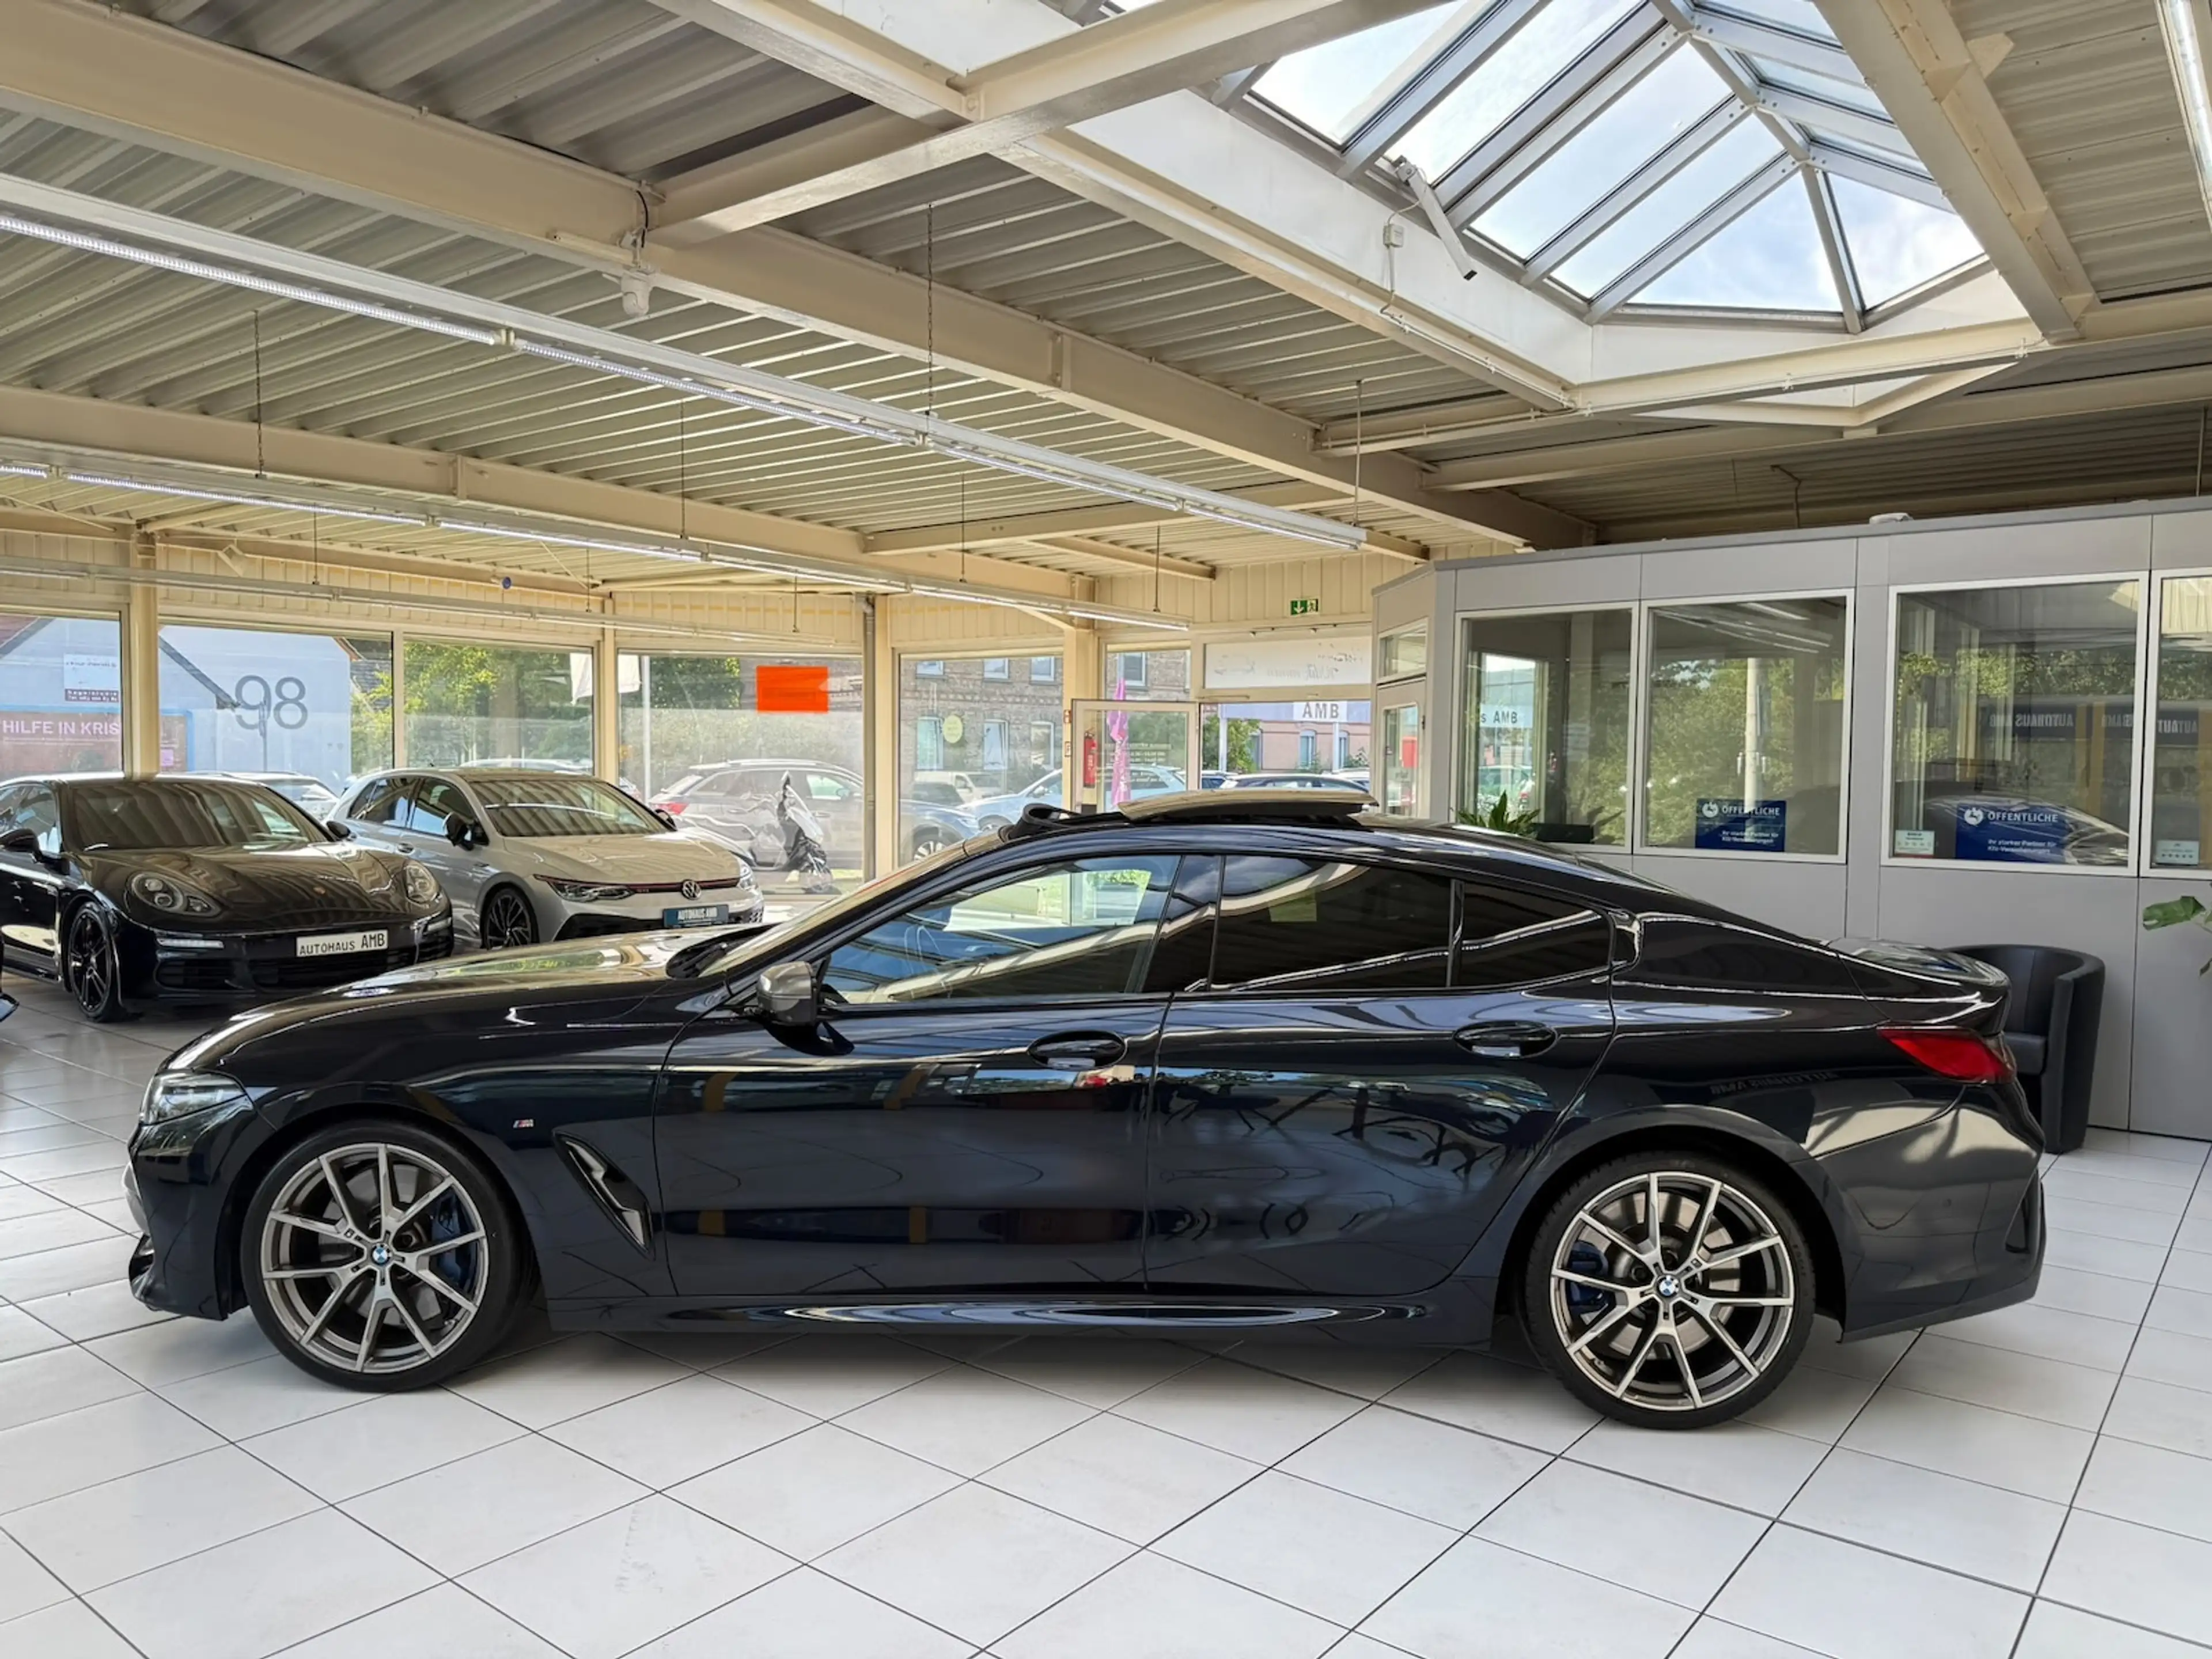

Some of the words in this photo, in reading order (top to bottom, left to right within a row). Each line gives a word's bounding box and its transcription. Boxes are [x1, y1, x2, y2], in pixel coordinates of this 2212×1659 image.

[235, 675, 308, 730] 98
[1302, 702, 1339, 719] AMB
[1493, 710, 1517, 724] AMB
[2, 721, 54, 734] HILFE
[59, 721, 75, 734] IN
[1721, 804, 1781, 816] ÖFFELICHE
[1988, 810, 2058, 823] ÖFFENTLICHE
[300, 940, 355, 956] AUTOHAUS
[361, 933, 385, 949] AMB
